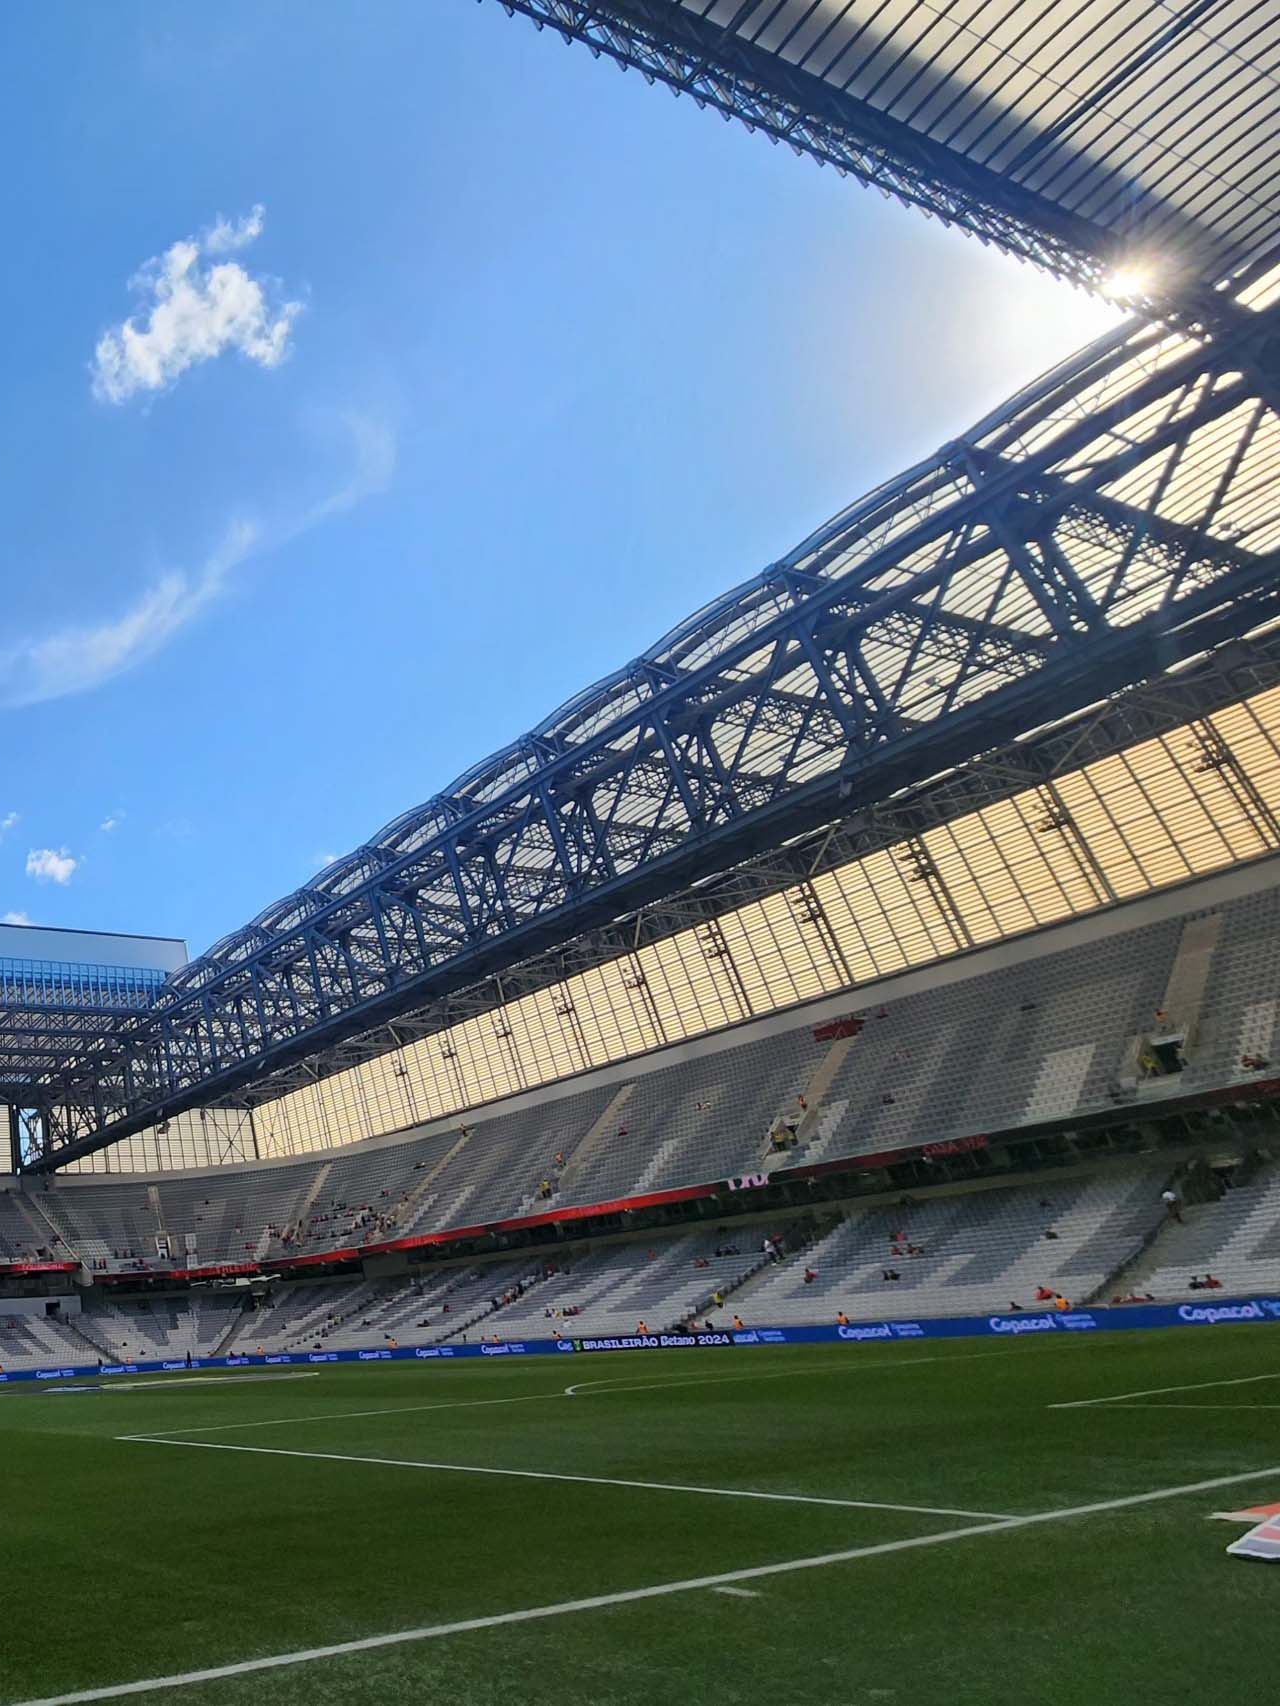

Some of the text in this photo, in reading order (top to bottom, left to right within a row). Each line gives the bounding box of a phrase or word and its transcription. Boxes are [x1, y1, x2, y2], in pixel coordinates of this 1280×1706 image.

[1179, 1302, 1264, 1323] Copacol
[838, 1324, 892, 1340] Copacol
[989, 1314, 1056, 1333] Copacol
[583, 1334, 730, 1350] BRASILEIRÃO Betano 2024
